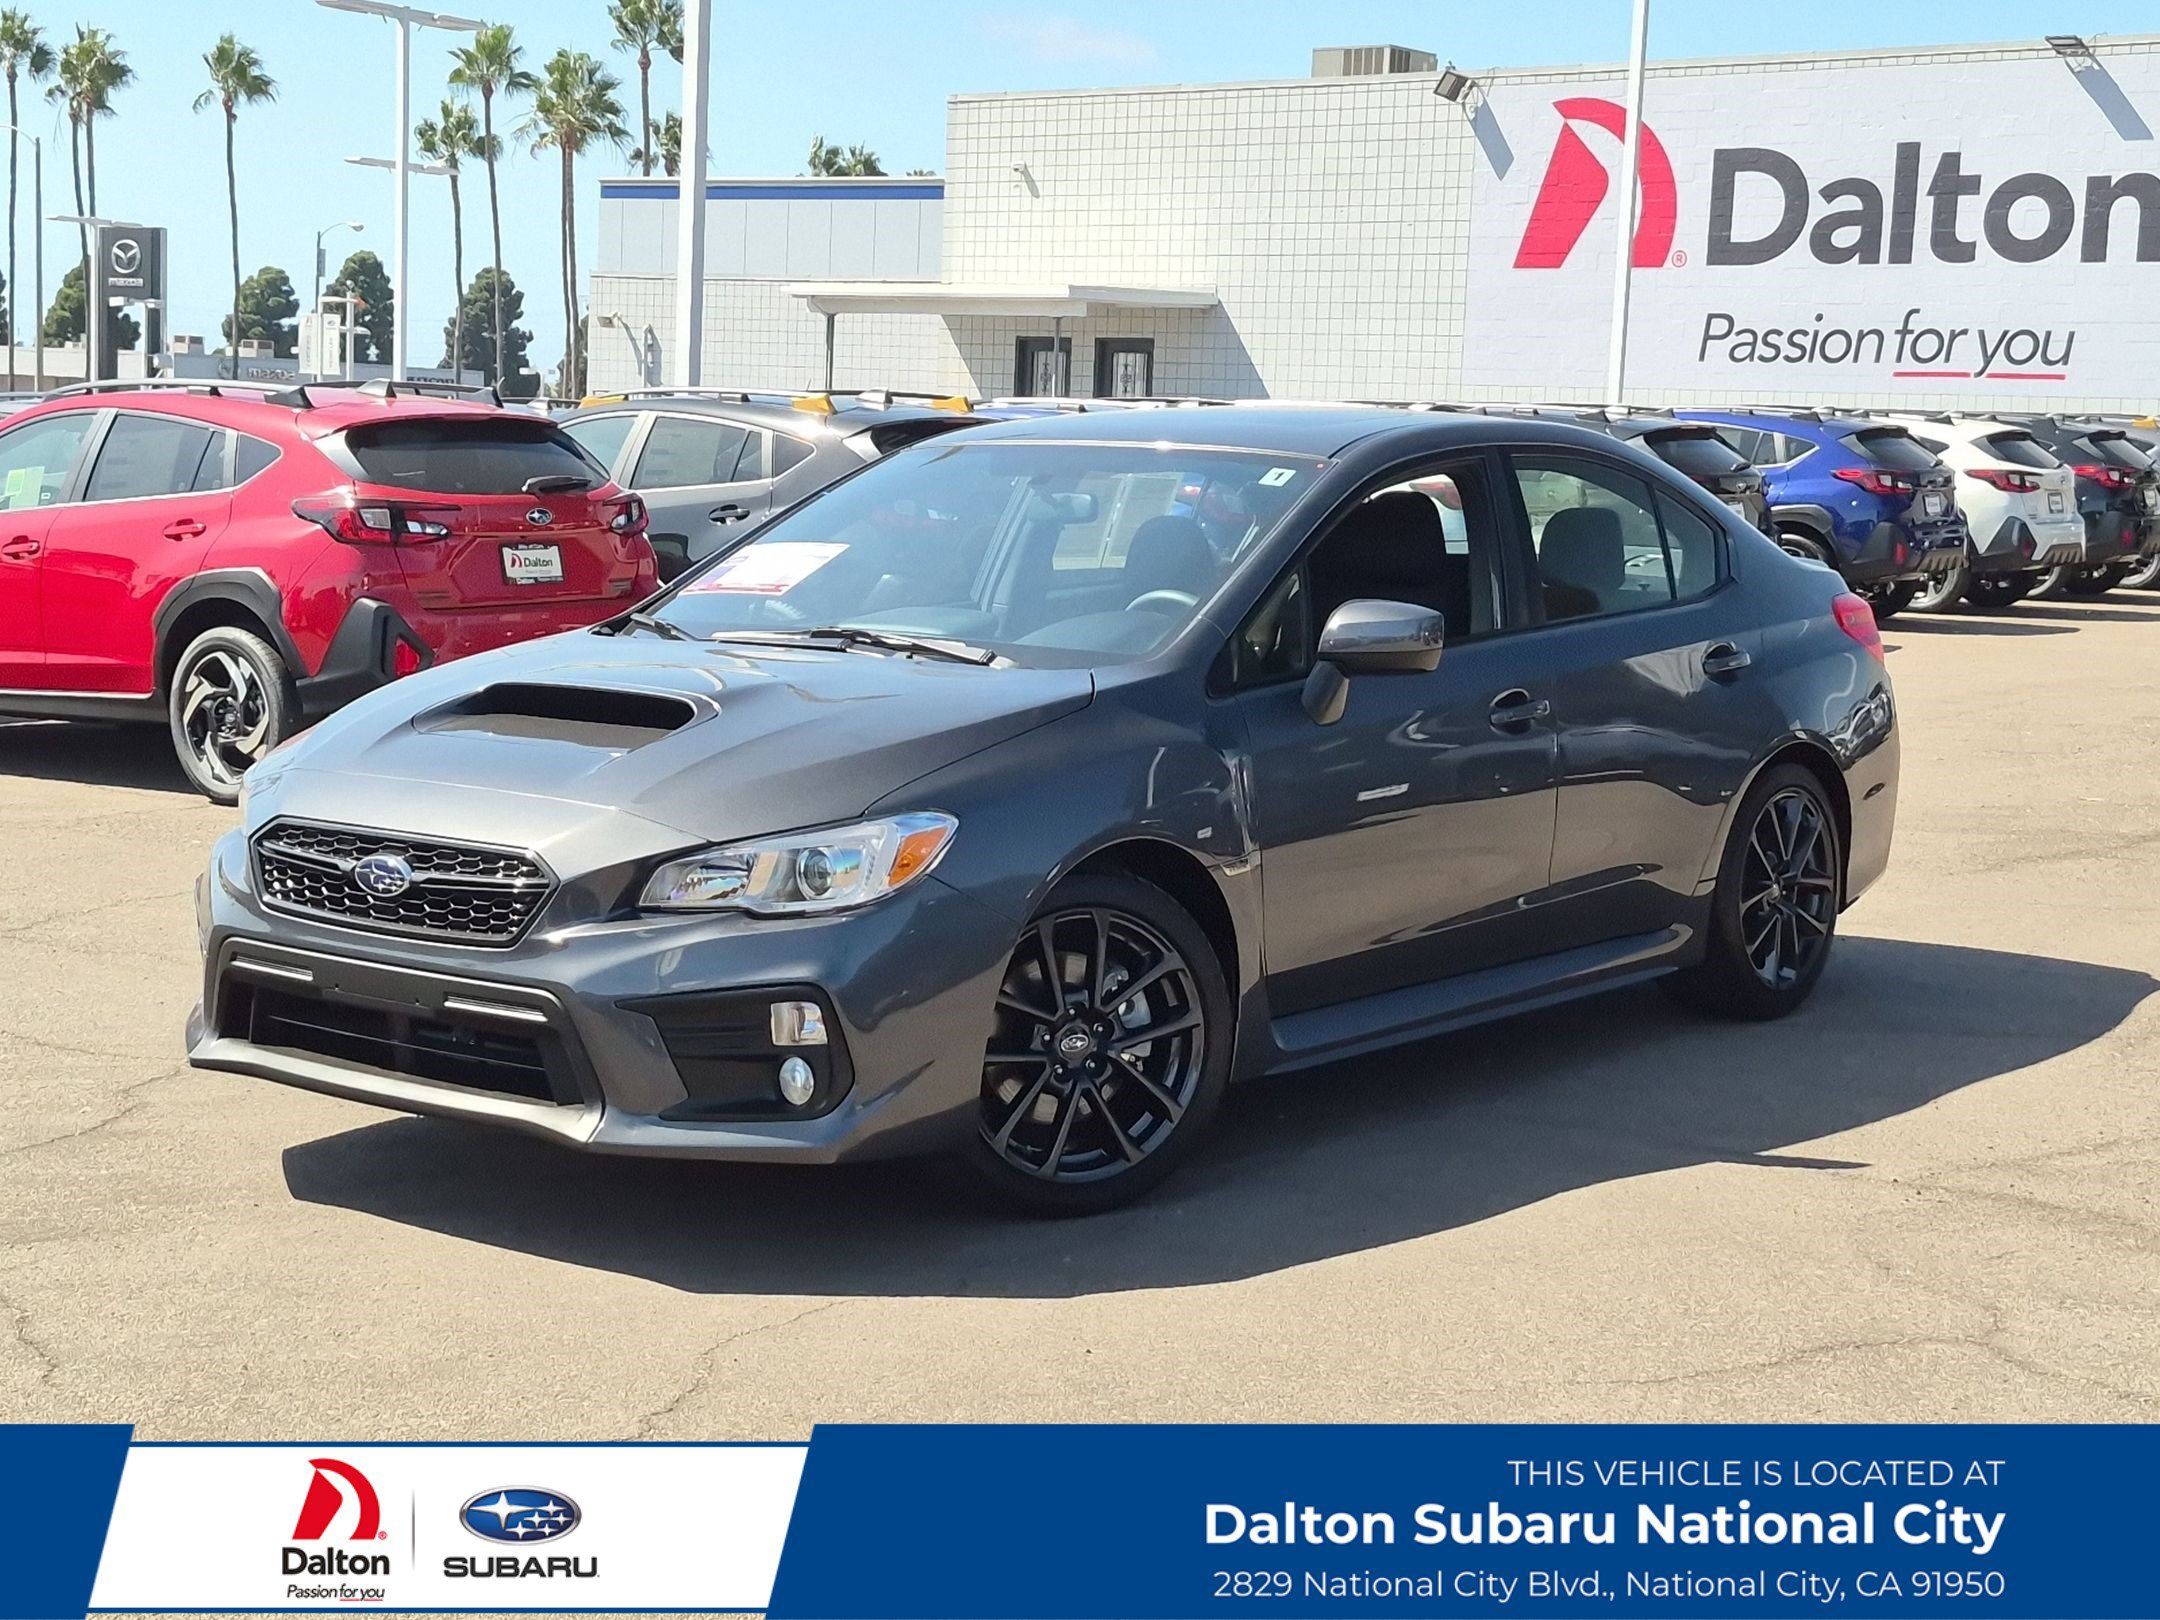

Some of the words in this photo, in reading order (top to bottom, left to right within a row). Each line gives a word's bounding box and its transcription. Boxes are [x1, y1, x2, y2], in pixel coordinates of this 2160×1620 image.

[1706, 141, 2160, 266] Dalton
[1698, 312, 1885, 364] Passion
[1895, 308, 1969, 364] for
[1973, 328, 2076, 379] you
[523, 556, 553, 568] Dalton
